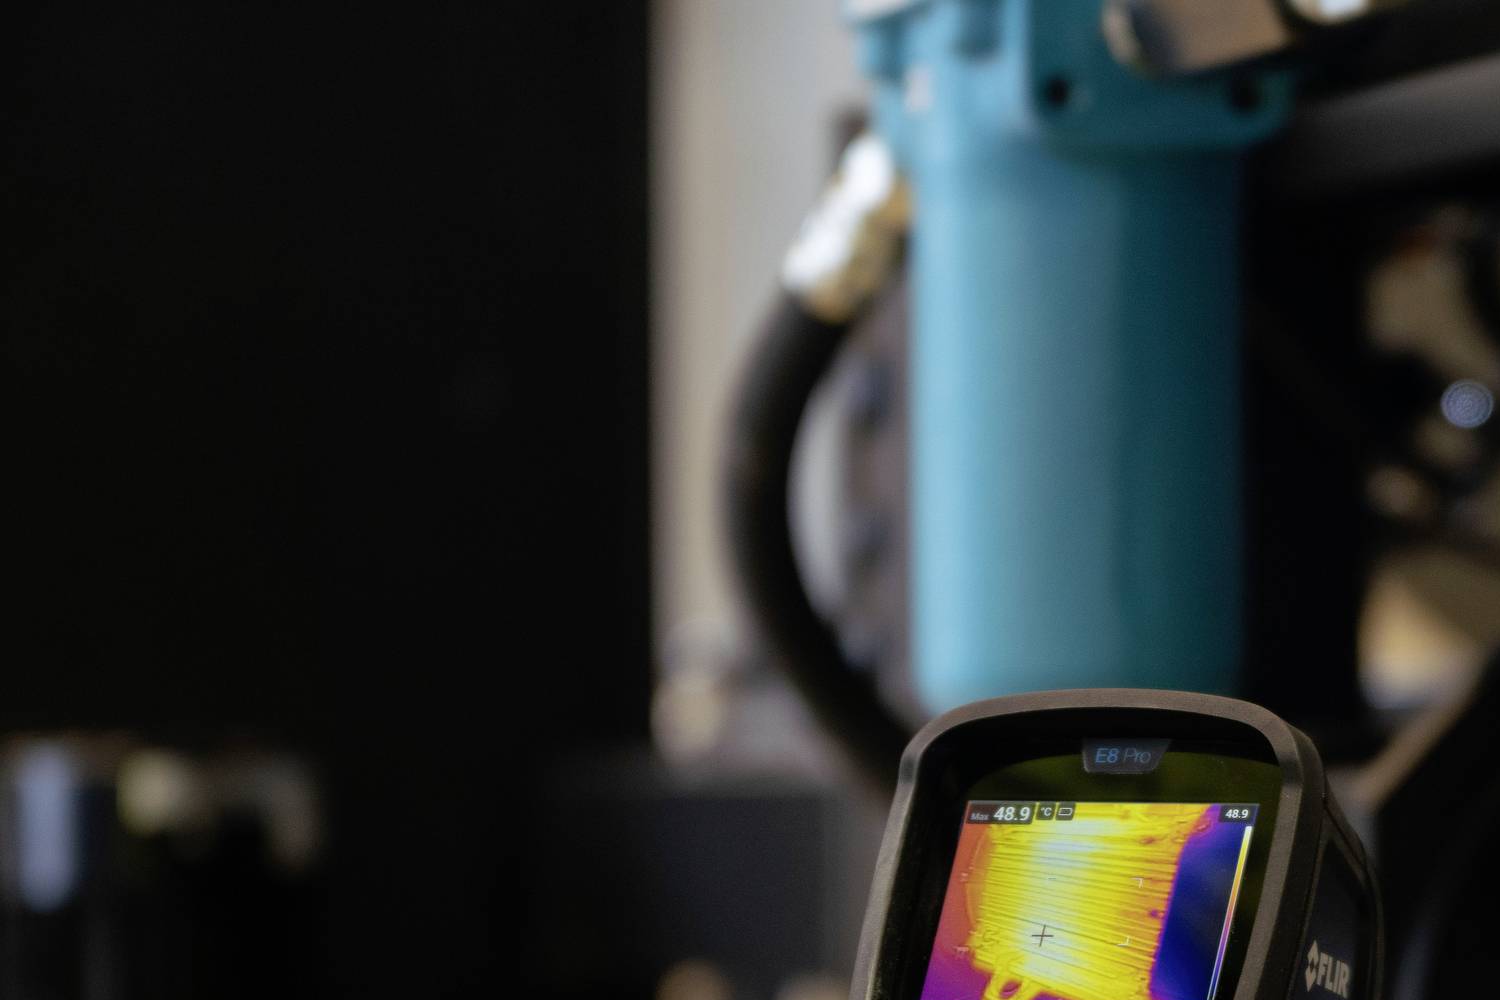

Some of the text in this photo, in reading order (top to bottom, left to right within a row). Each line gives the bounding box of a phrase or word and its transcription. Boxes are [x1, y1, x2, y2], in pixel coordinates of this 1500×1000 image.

[1095, 747, 1152, 764] E8 Pro
[970, 812, 989, 821] Max
[993, 806, 1031, 821] 48.9
[1225, 809, 1249, 819] 48.9
[1317, 951, 1350, 1000] FLIR
